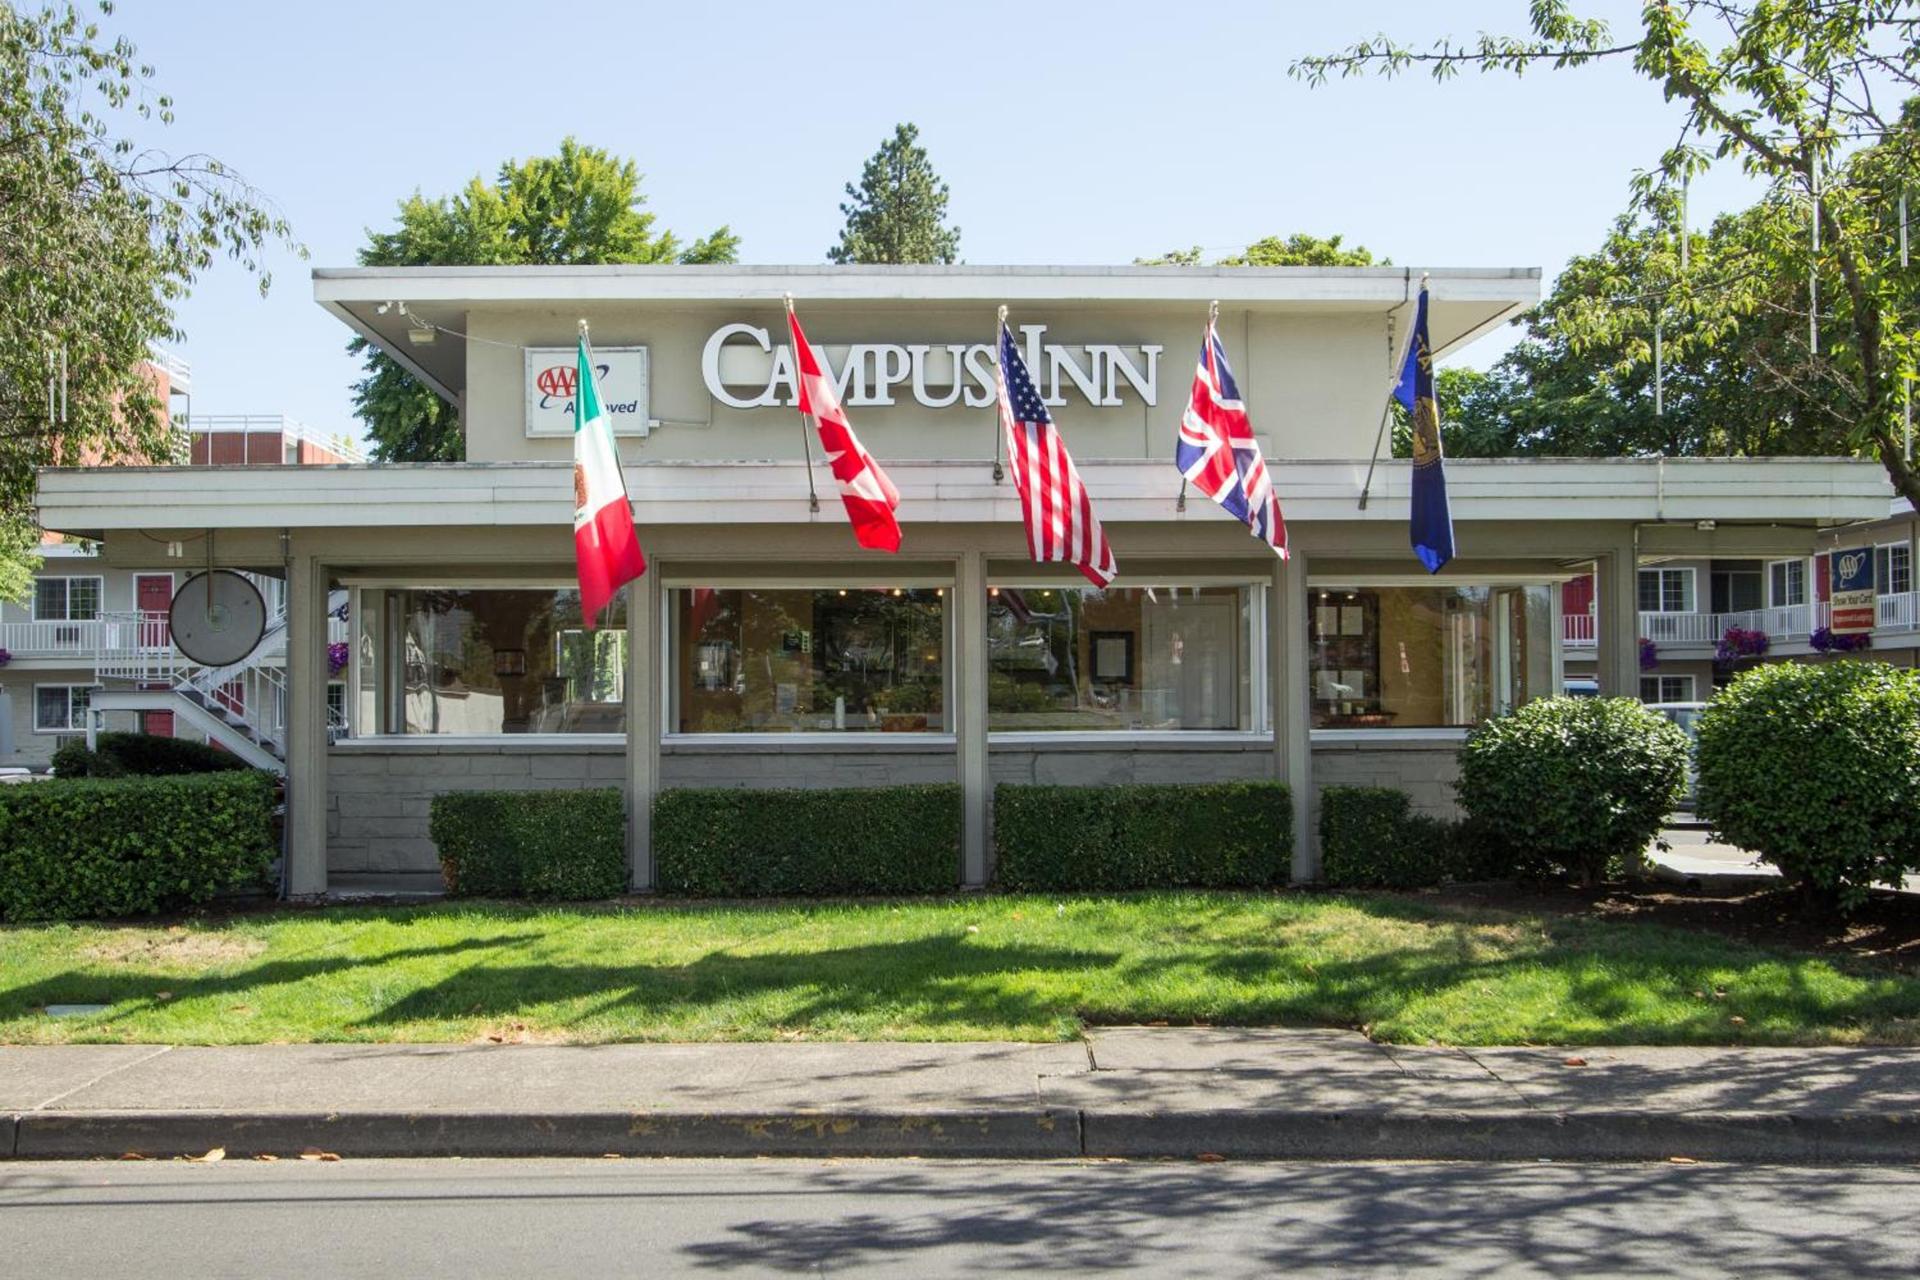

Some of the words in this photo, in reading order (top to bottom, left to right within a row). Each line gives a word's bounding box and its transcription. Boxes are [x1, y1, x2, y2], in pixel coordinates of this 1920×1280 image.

[702, 323, 998, 408] CAMPUS
[1019, 325, 1163, 407] INN
[563, 400, 638, 413] Aved
